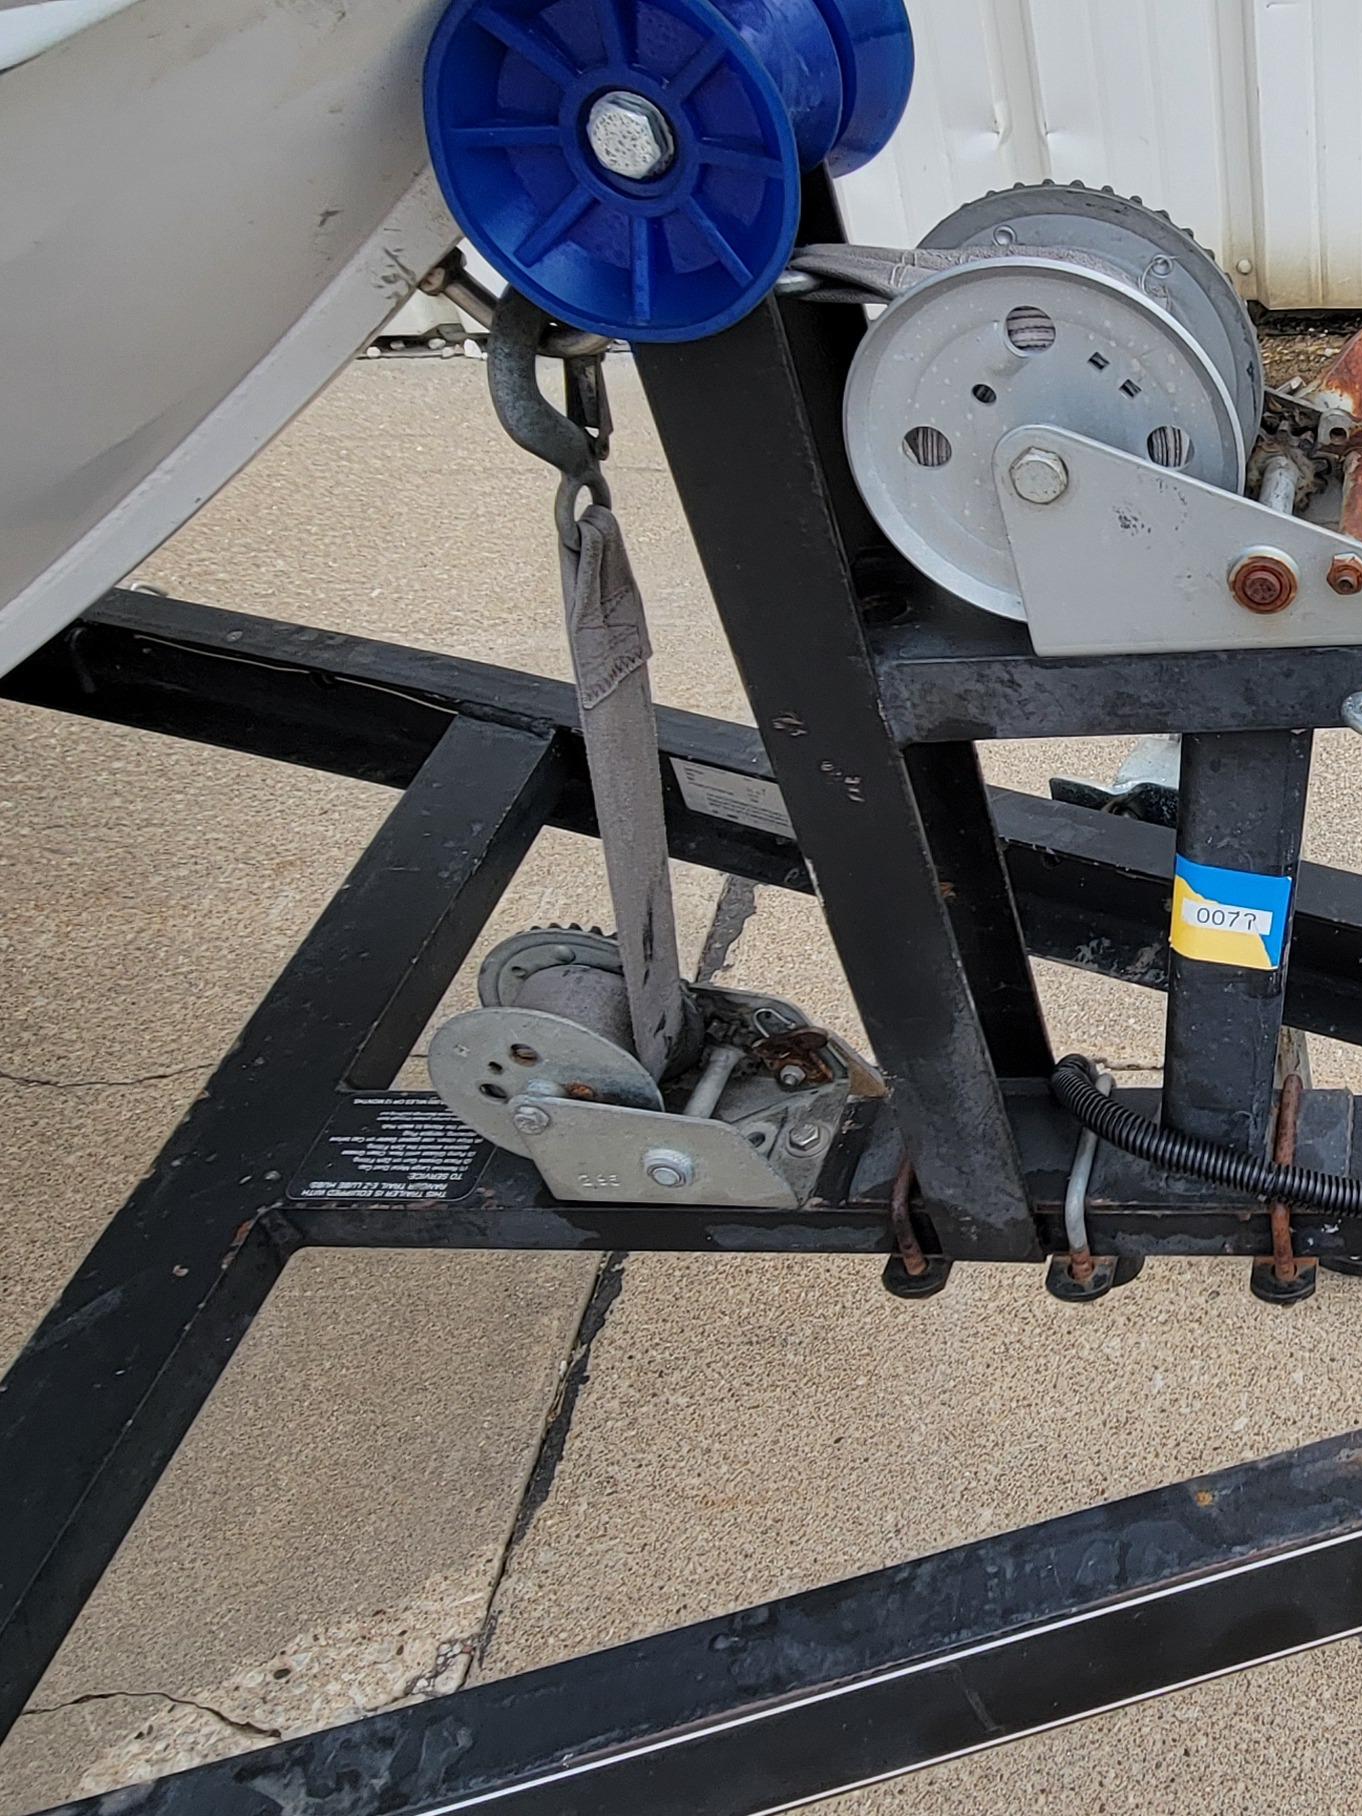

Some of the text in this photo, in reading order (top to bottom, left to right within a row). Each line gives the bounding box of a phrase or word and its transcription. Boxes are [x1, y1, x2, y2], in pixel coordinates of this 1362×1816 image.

[449, 1172, 463, 1180] TO
[381, 1182, 407, 1190] TRAIL
[301, 1189, 326, 1197] WITH
[326, 1189, 374, 1197] EQUIPPED
[384, 1190, 424, 1198] TRAILER
